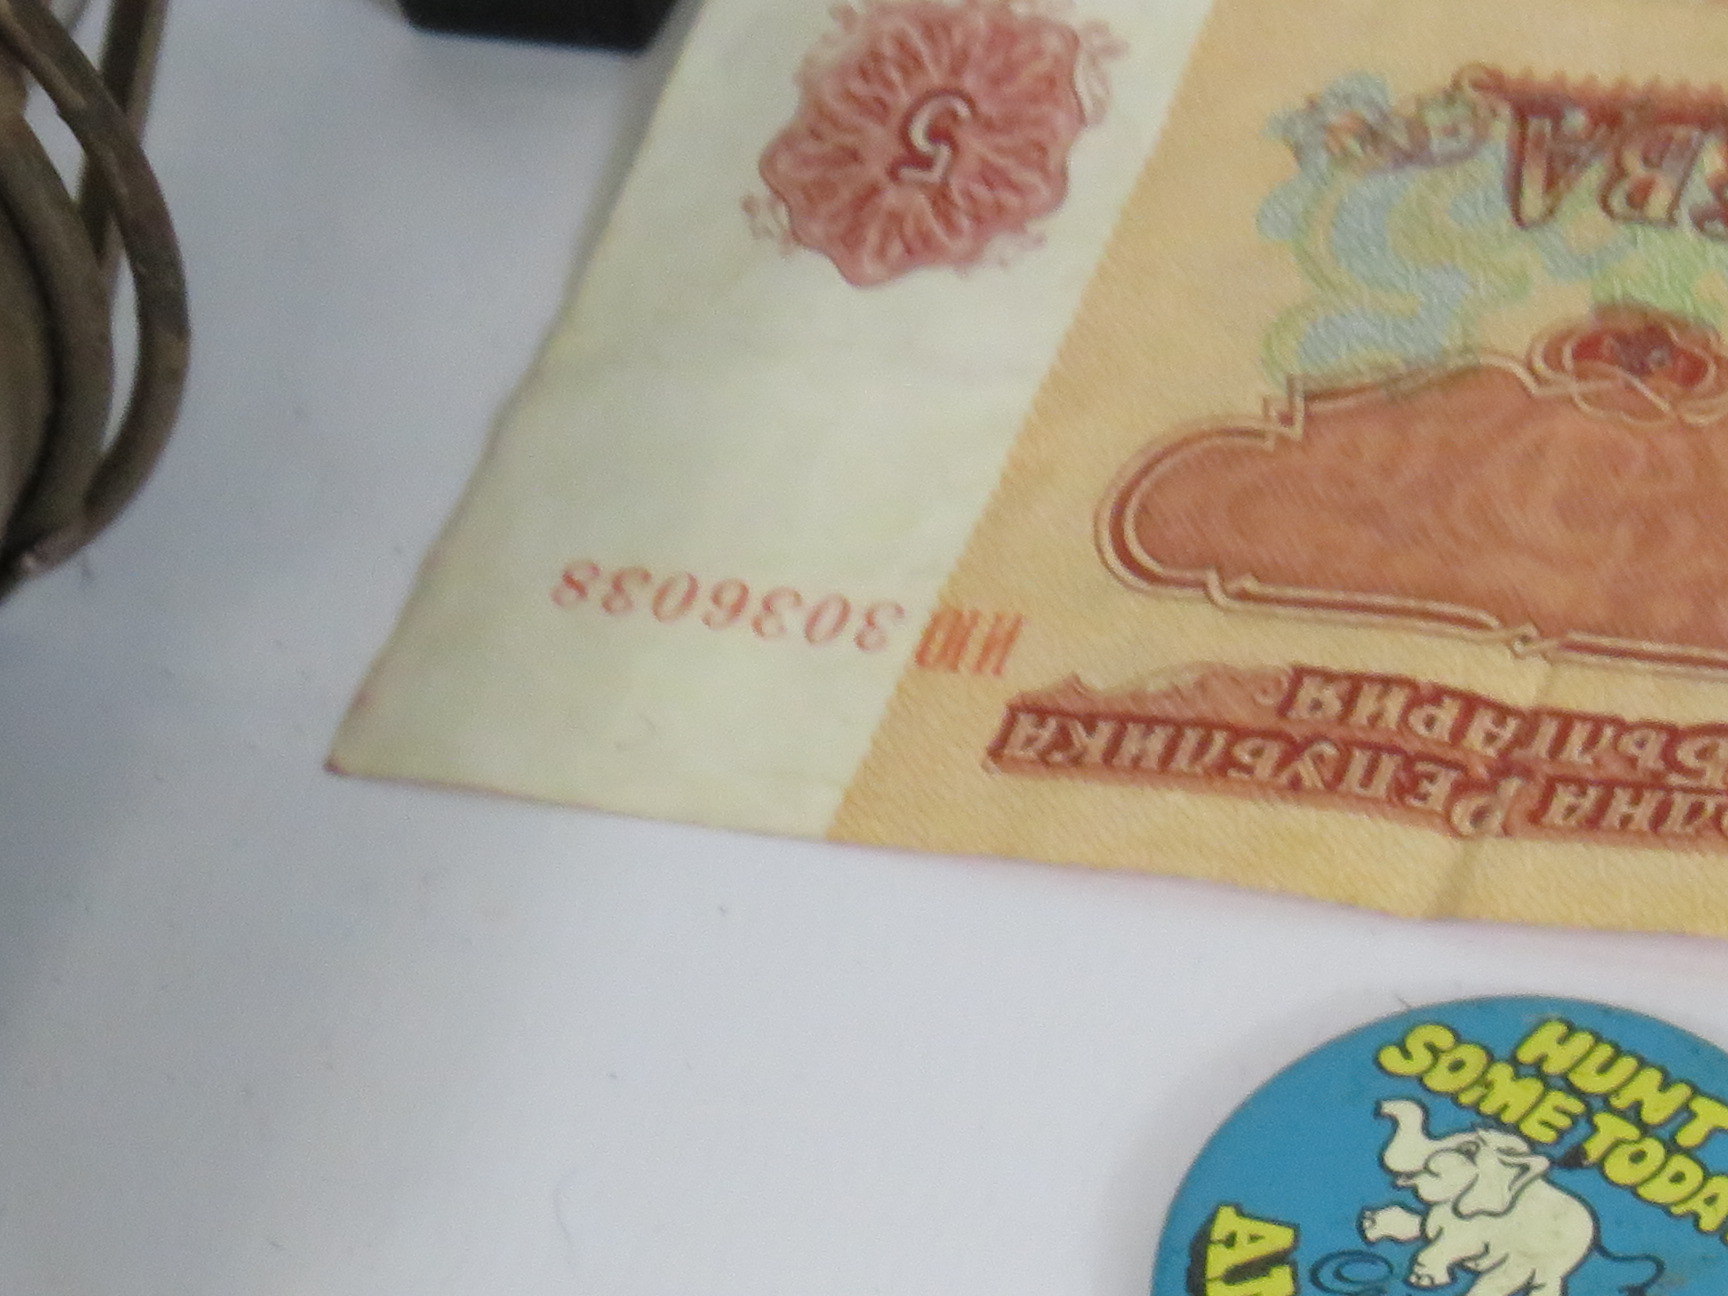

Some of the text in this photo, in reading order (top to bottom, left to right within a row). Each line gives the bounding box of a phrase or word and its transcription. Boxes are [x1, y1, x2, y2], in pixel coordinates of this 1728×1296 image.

[888, 88, 976, 186] 5
[551, 560, 906, 654] 3036038
[1001, 708, 1510, 838] РЕПУБЛИКА
[1375, 1022, 1587, 1147] SOME
